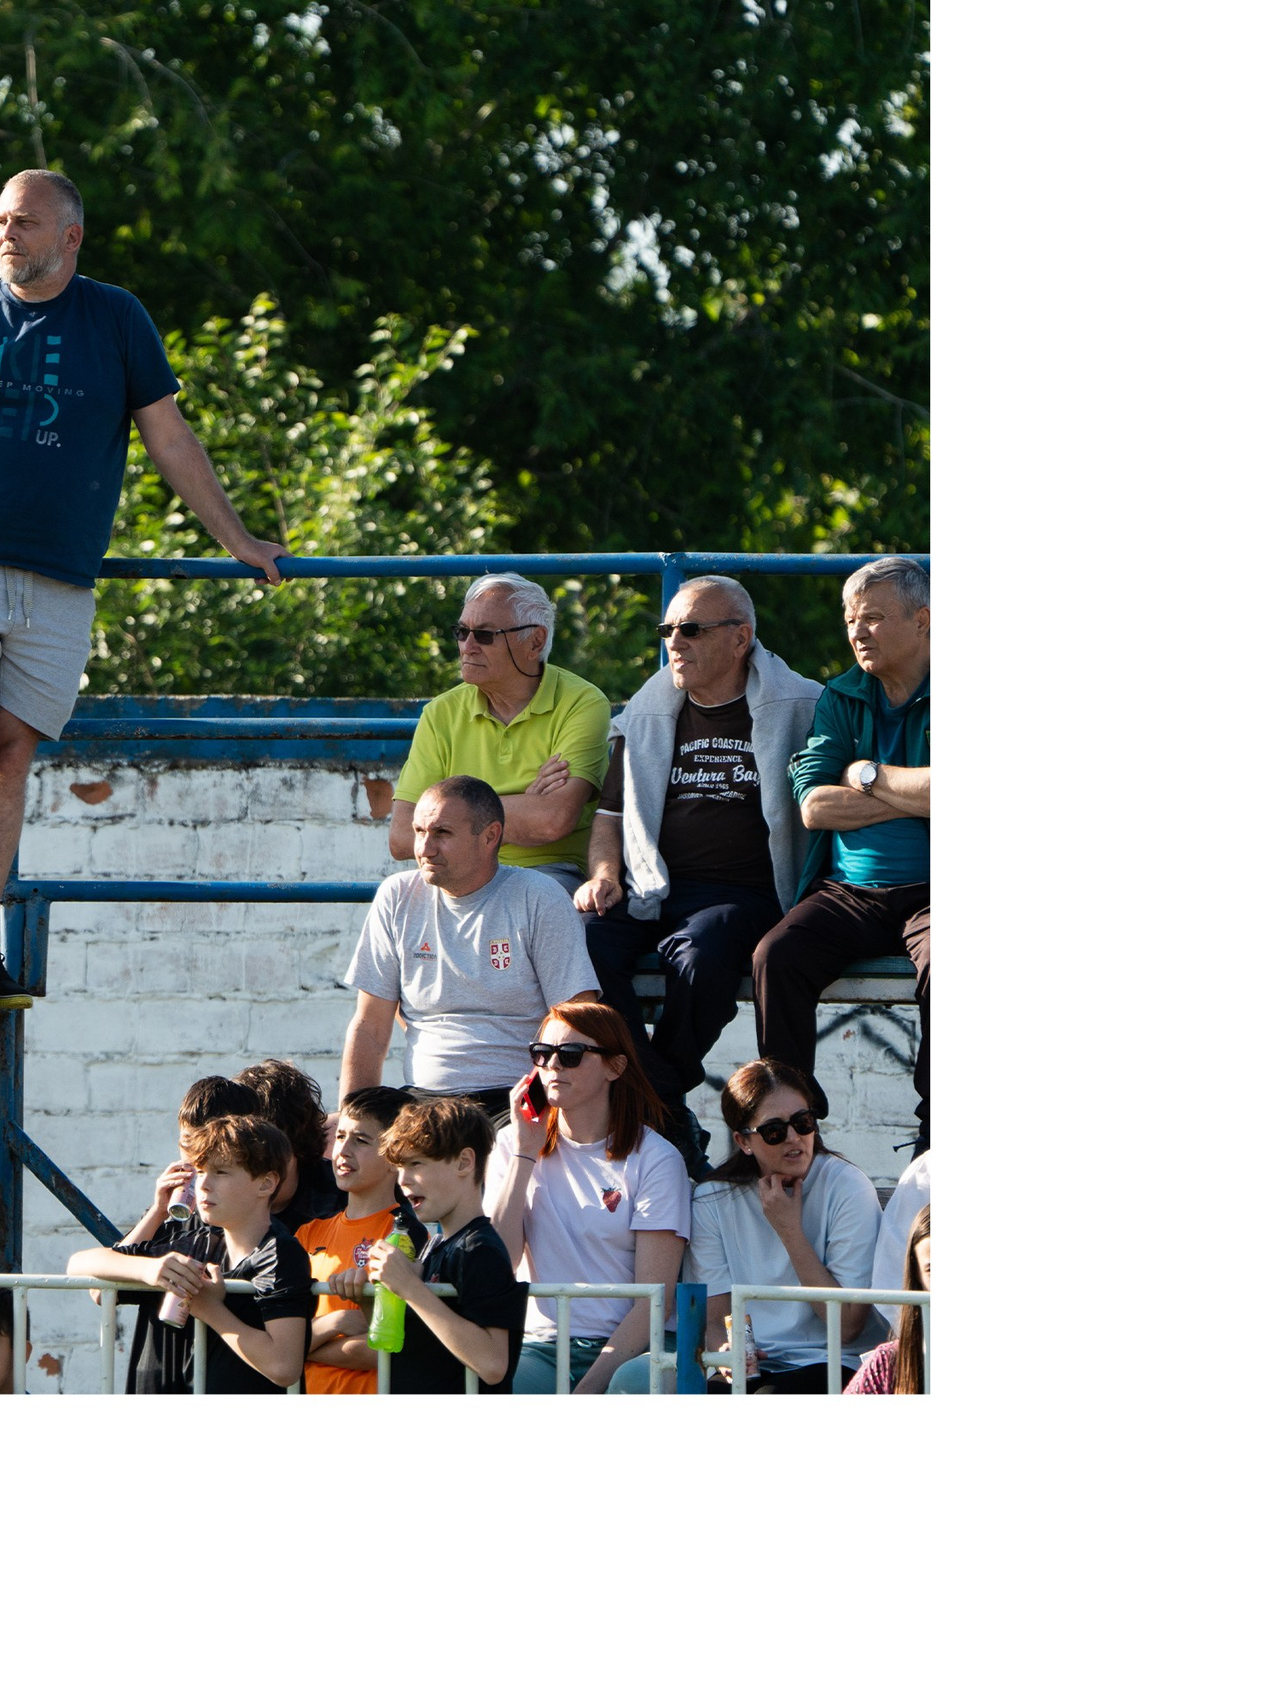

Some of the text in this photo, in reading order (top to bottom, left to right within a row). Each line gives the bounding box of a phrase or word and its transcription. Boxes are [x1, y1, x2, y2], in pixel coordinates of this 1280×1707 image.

[22, 384, 85, 397] MOVING
[35, 429, 62, 448] UP.
[680, 738, 710, 756] PACIFIC
[694, 755, 743, 763] EXPERIENCE
[670, 767, 726, 785] Ventura
